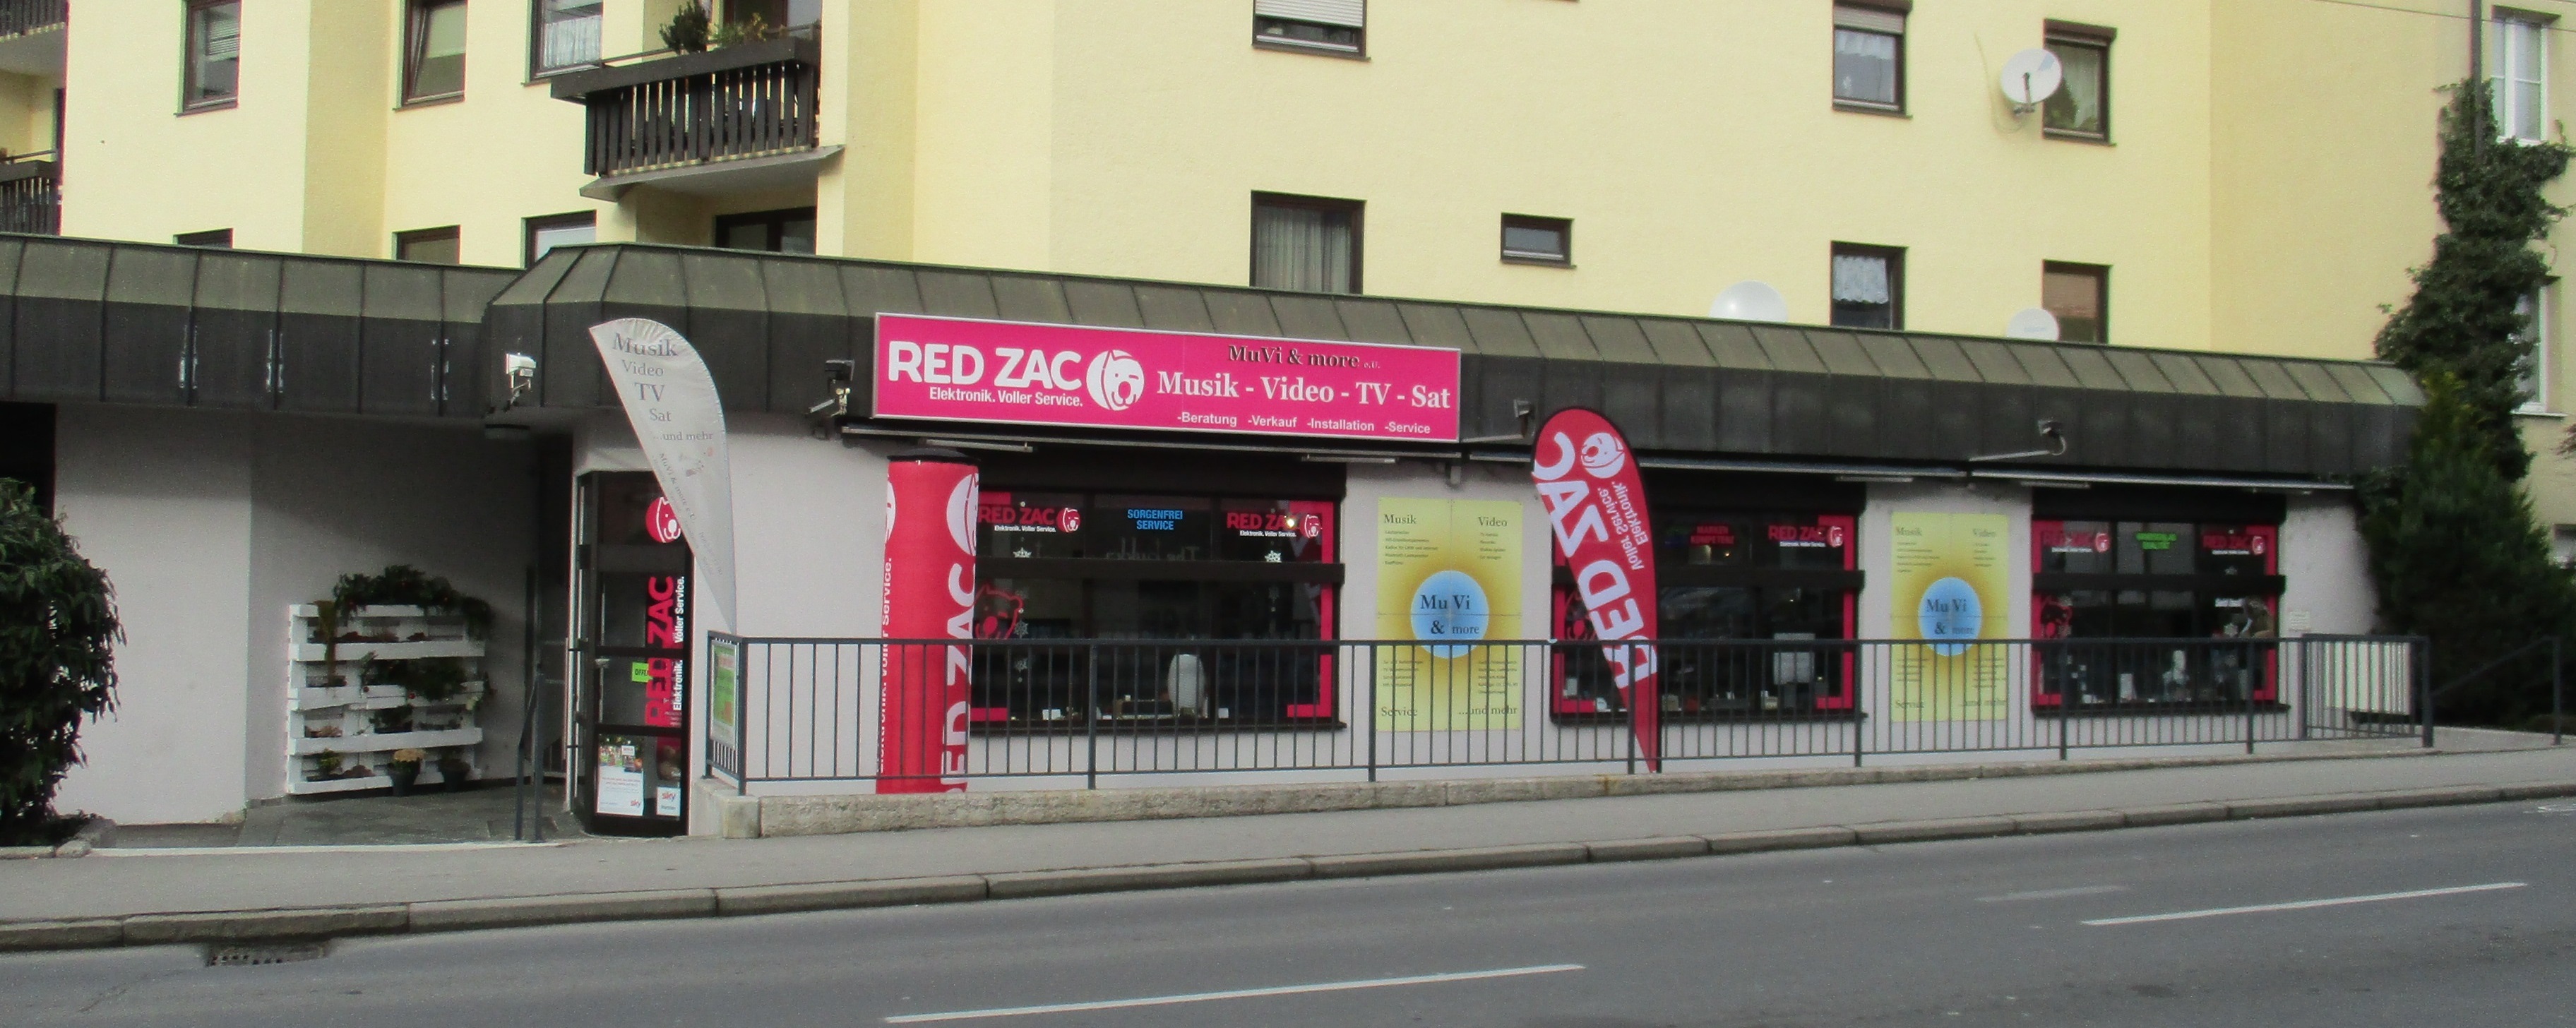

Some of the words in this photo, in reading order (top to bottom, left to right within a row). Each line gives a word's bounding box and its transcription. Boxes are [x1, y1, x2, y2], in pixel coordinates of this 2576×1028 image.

[613, 333, 679, 357] Musik
[888, 341, 984, 385] RED
[994, 347, 1082, 390] ZAC
[1229, 345, 1282, 364] MuVi
[1288, 348, 1303, 364] &
[1308, 353, 1359, 368] more
[622, 359, 664, 376] Video
[634, 382, 665, 402] TV
[929, 386, 996, 402] Elektronik.
[998, 390, 1032, 404] Voller
[1035, 392, 1083, 407] Service.
[1157, 371, 1239, 398] Musik
[1260, 376, 1334, 402] Video
[1356, 382, 1392, 405] TV
[1412, 385, 1450, 408] Sat
[649, 408, 672, 422] Sat
[1177, 412, 1237, 427] -Beratung
[1248, 414, 1297, 428] -Verkauf
[1307, 418, 1374, 431] -Installation
[1385, 422, 1431, 434] -Service
[686, 431, 713, 441] mehr
[977, 506, 1016, 523] RED
[1019, 508, 1055, 525] ZAC
[1127, 509, 1183, 520] SORGENFREI
[1227, 513, 1263, 529] RED
[1384, 514, 1417, 524] Musik
[1478, 516, 1508, 527] Video
[1136, 520, 1174, 530] SERVICE
[1768, 525, 1797, 540] RED
[675, 576, 684, 615] Service.
[647, 576, 674, 649] ZAC
[674, 616, 684, 643] Voller
[1431, 620, 1445, 634] &
[1453, 626, 1479, 634] more
[1934, 621, 1946, 635] &
[645, 657, 672, 728] RED
[673, 659, 683, 710] Elektronik.
[662, 792, 676, 802] sky
